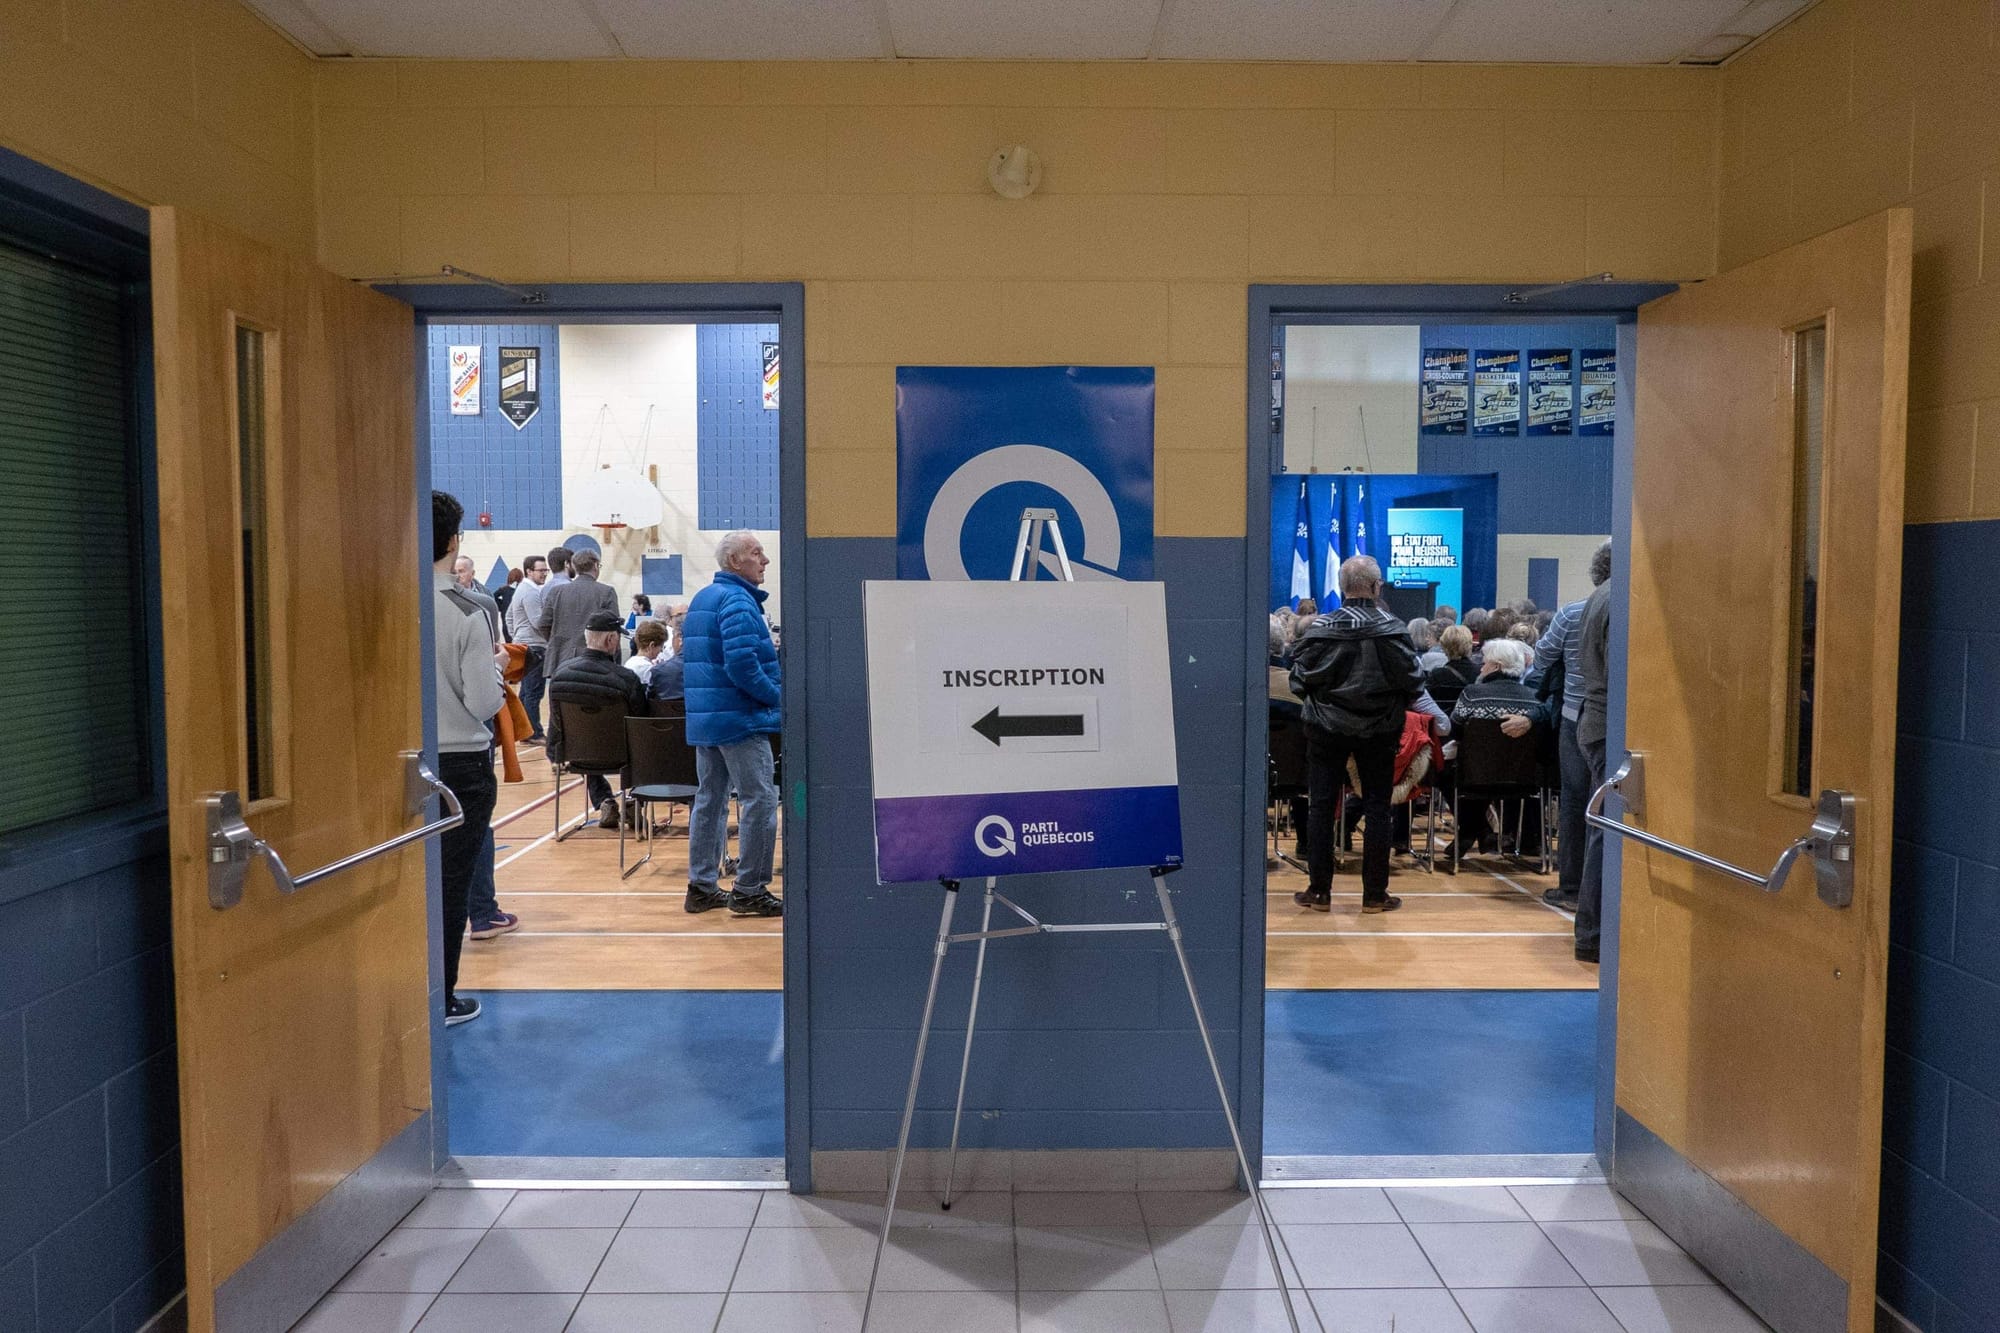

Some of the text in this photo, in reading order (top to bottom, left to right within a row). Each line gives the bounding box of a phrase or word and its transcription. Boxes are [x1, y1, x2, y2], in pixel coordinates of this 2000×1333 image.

[1425, 354, 1467, 367] Champions
[1531, 355, 1568, 367] Champions
[1404, 533, 1422, 545] ÉTAT
[1422, 535, 1442, 545] FORT
[1391, 545, 1413, 556] POUR
[943, 668, 1105, 688] INSCRIPTION
[1022, 821, 1058, 834] PARTI
[1023, 831, 1095, 847] QUÉBÉCOIS
